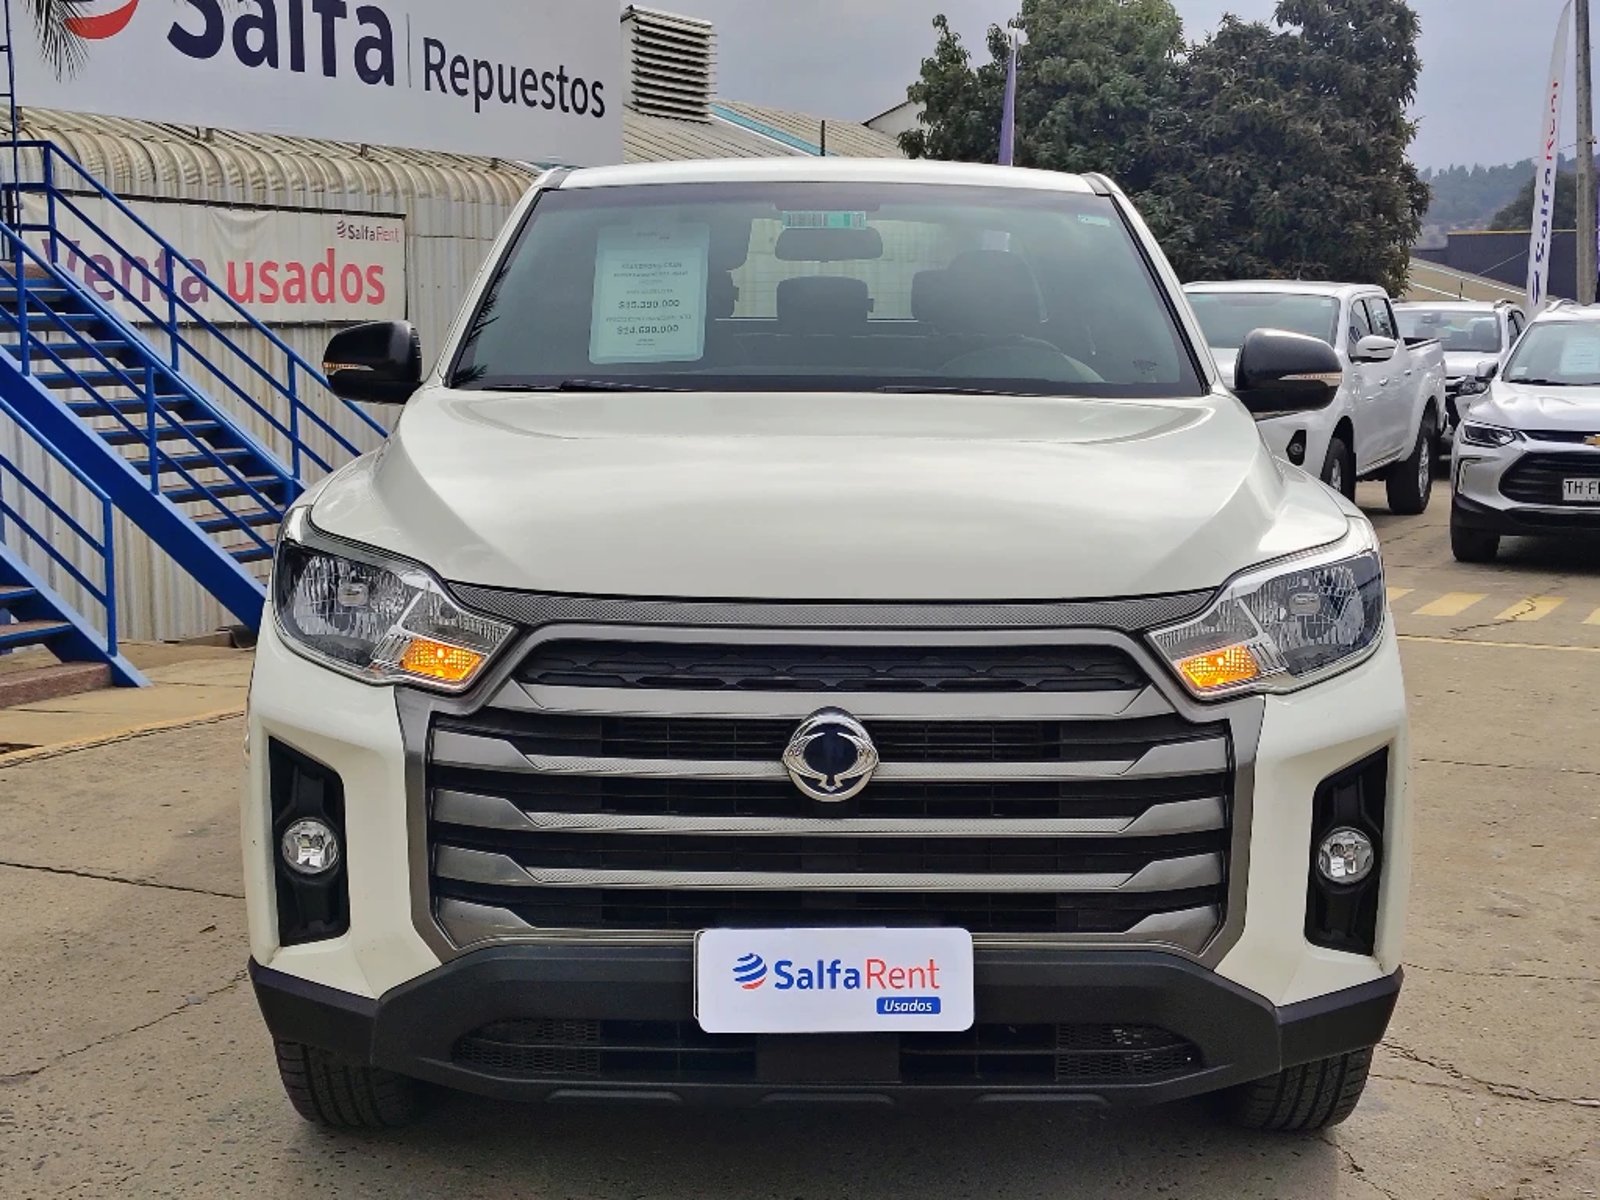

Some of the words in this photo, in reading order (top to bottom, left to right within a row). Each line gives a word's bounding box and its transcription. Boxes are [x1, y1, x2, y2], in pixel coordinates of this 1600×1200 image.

[423, 37, 605, 118] Repuestos
[347, 224, 400, 243] SalfaRent
[226, 248, 386, 305] usados
[774, 958, 940, 990] SalfaRent
[884, 1000, 933, 1012] Usados
